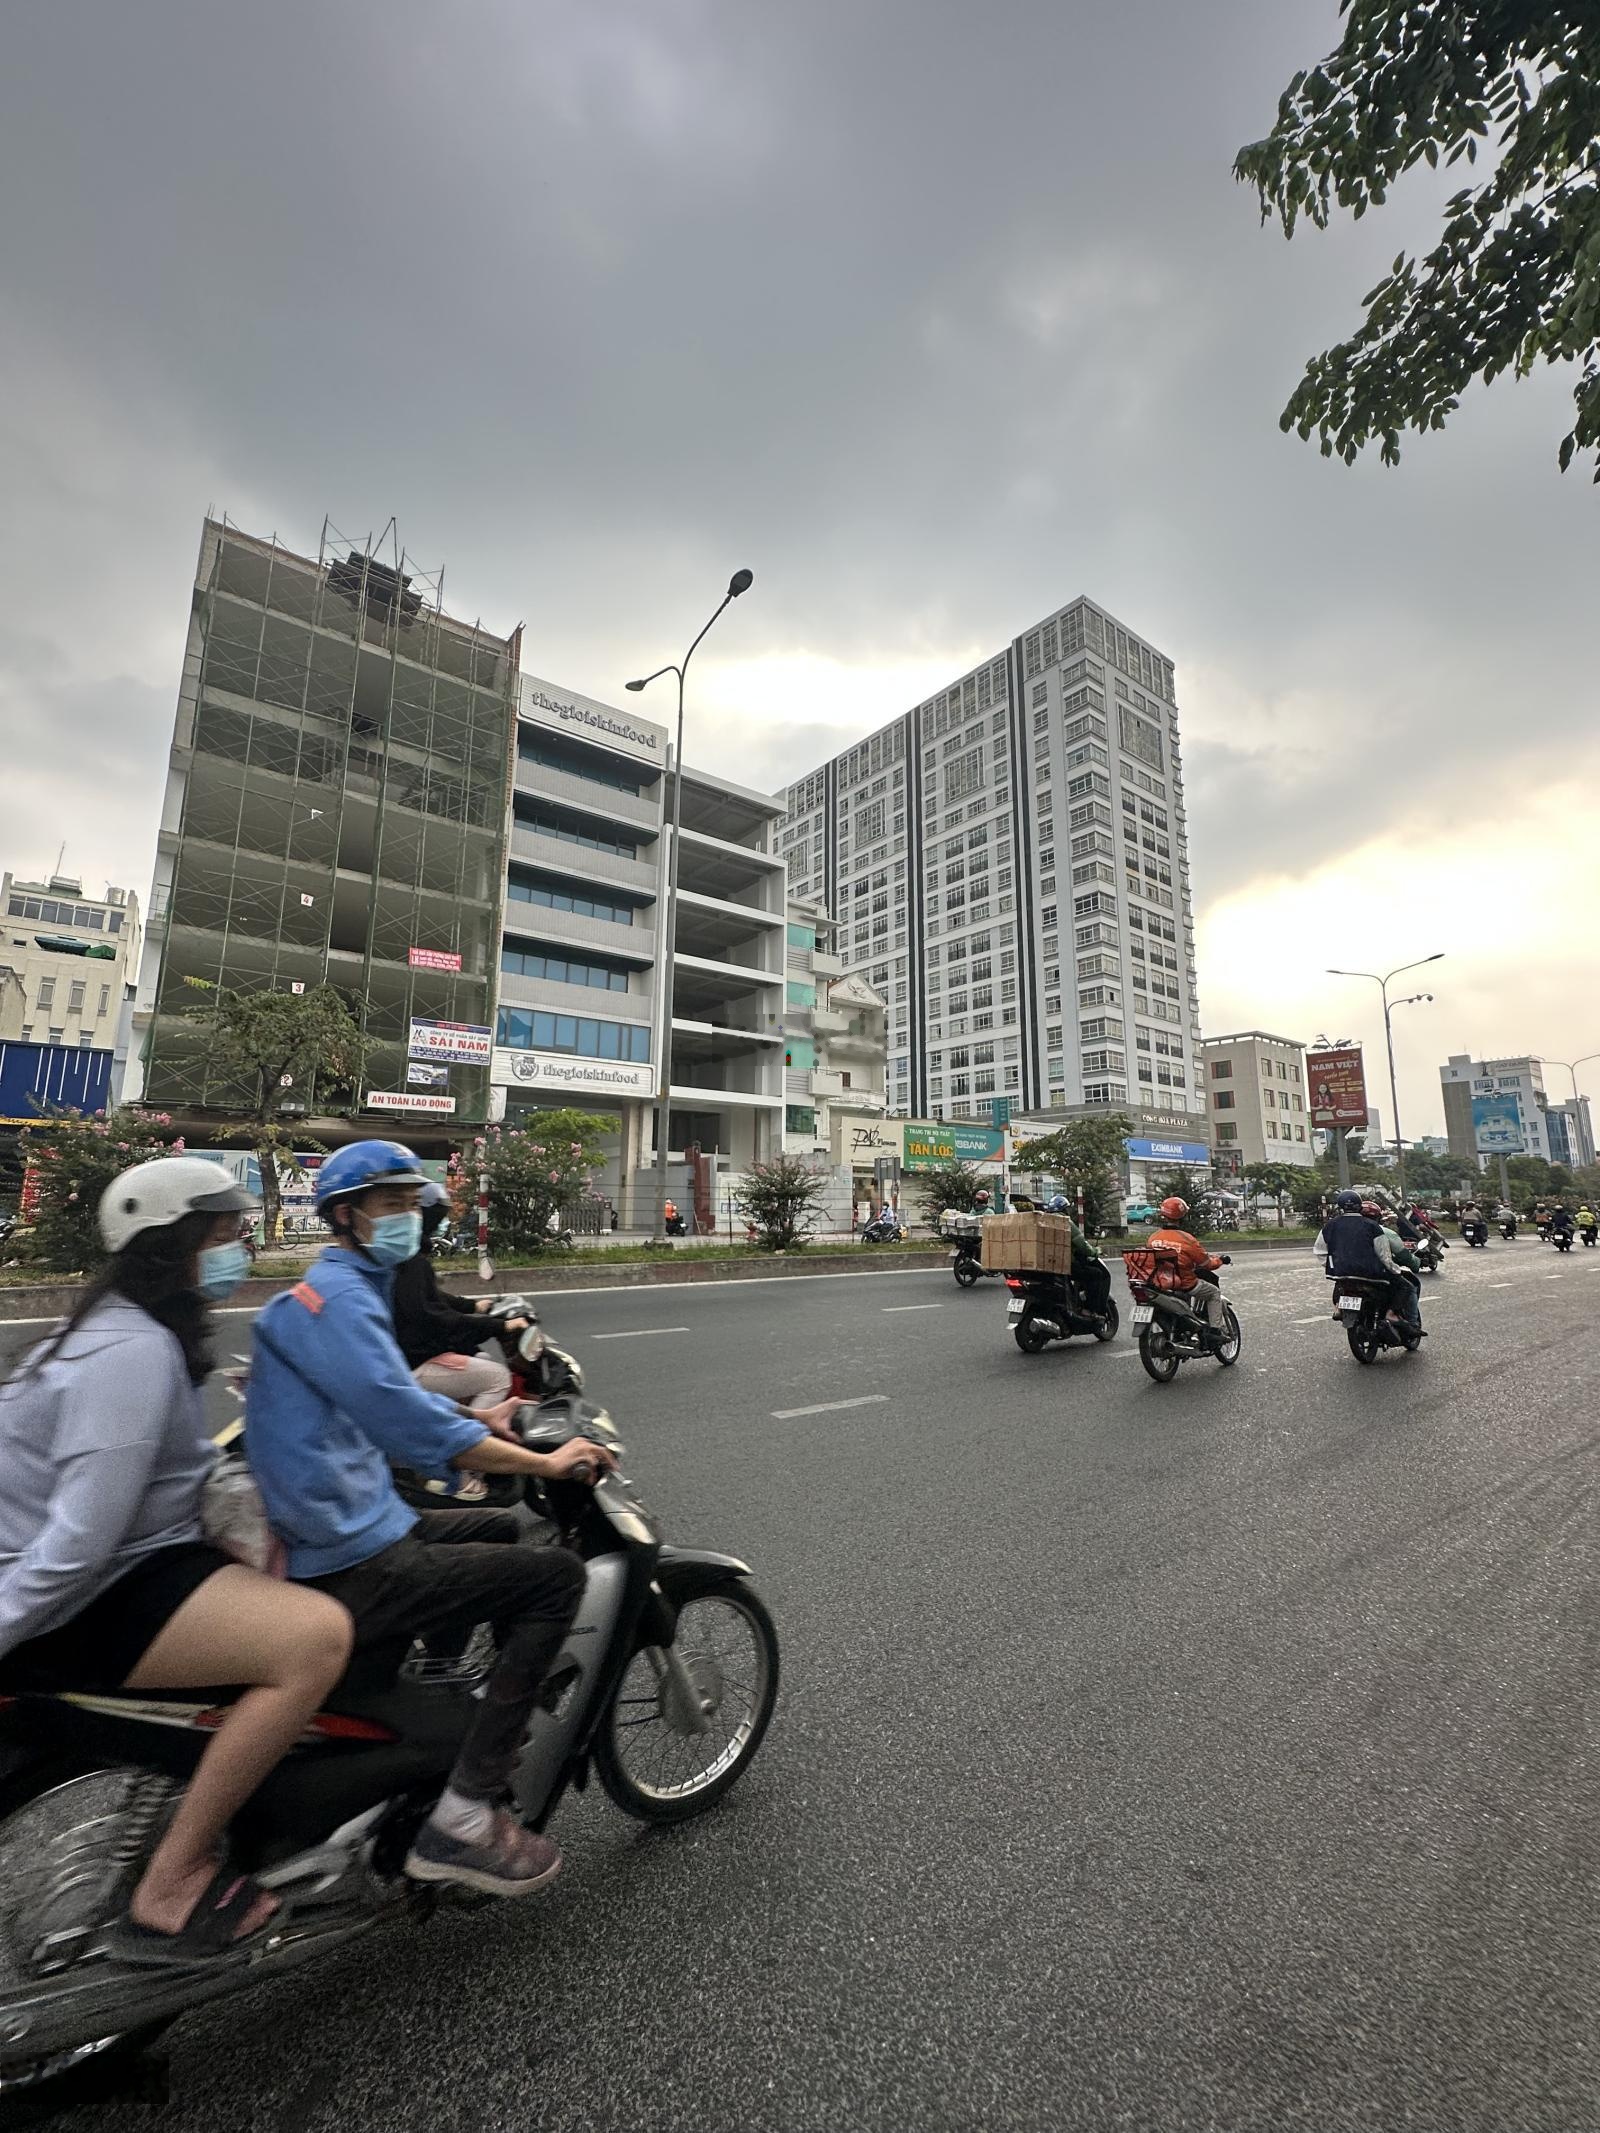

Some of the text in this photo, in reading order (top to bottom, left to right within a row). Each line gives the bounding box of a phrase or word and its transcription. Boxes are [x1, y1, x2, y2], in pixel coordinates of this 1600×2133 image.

[531, 691, 657, 748] thegioiskinfood
[457, 1039, 488, 1052] NAM
[1311, 1062, 1335, 1071] NAM
[543, 1063, 640, 1085] thegioiskinfood
[372, 1095, 384, 1104] AN
[411, 1098, 427, 1107] LAO
